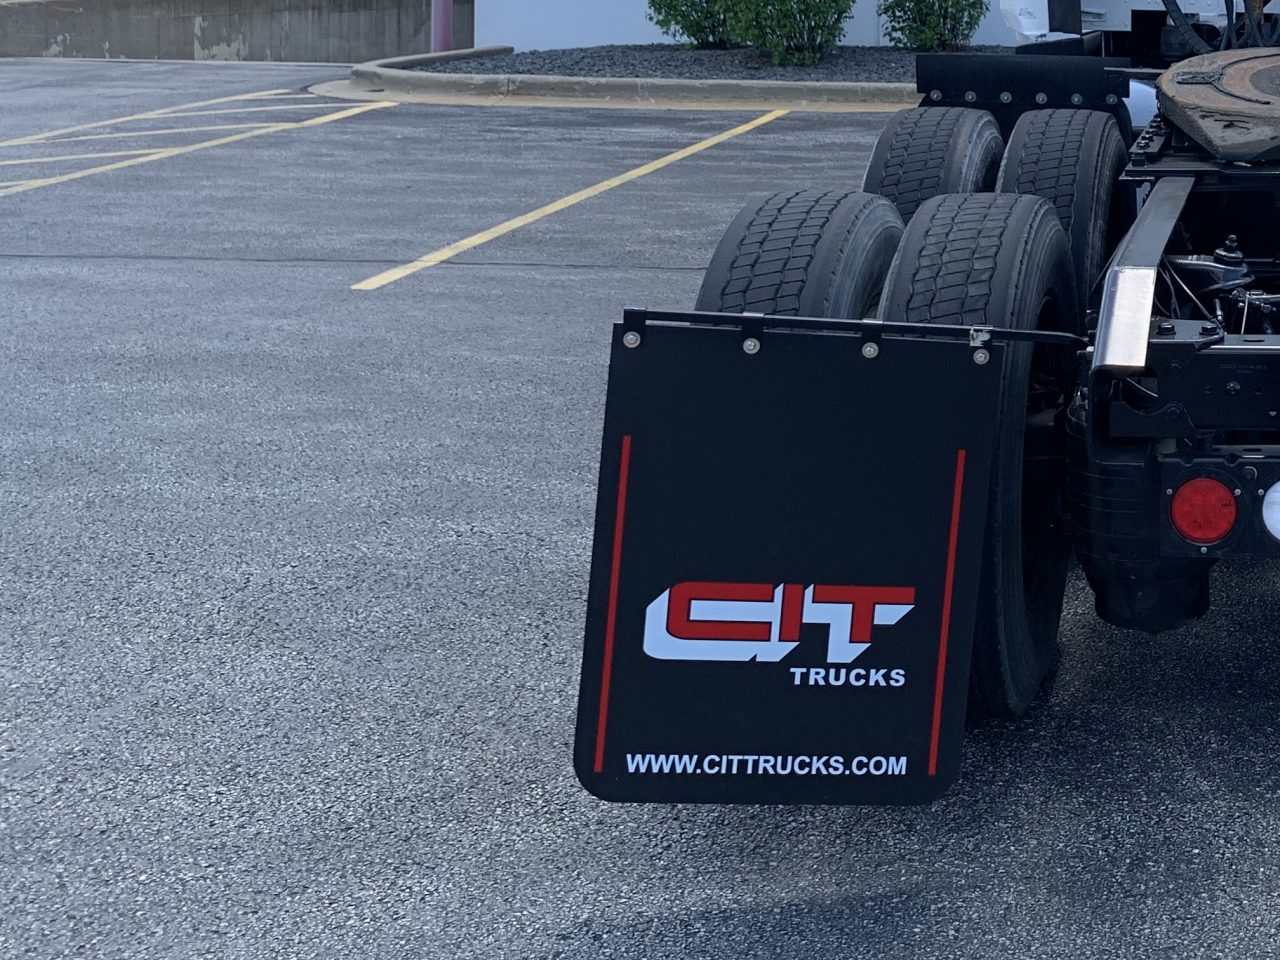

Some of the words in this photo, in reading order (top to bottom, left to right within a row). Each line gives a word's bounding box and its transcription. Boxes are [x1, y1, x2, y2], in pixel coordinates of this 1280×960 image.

[643, 581, 915, 663] CIT
[790, 667, 906, 687] TRUCKS
[626, 753, 907, 775] WWW.CITTRUCKS.COM
